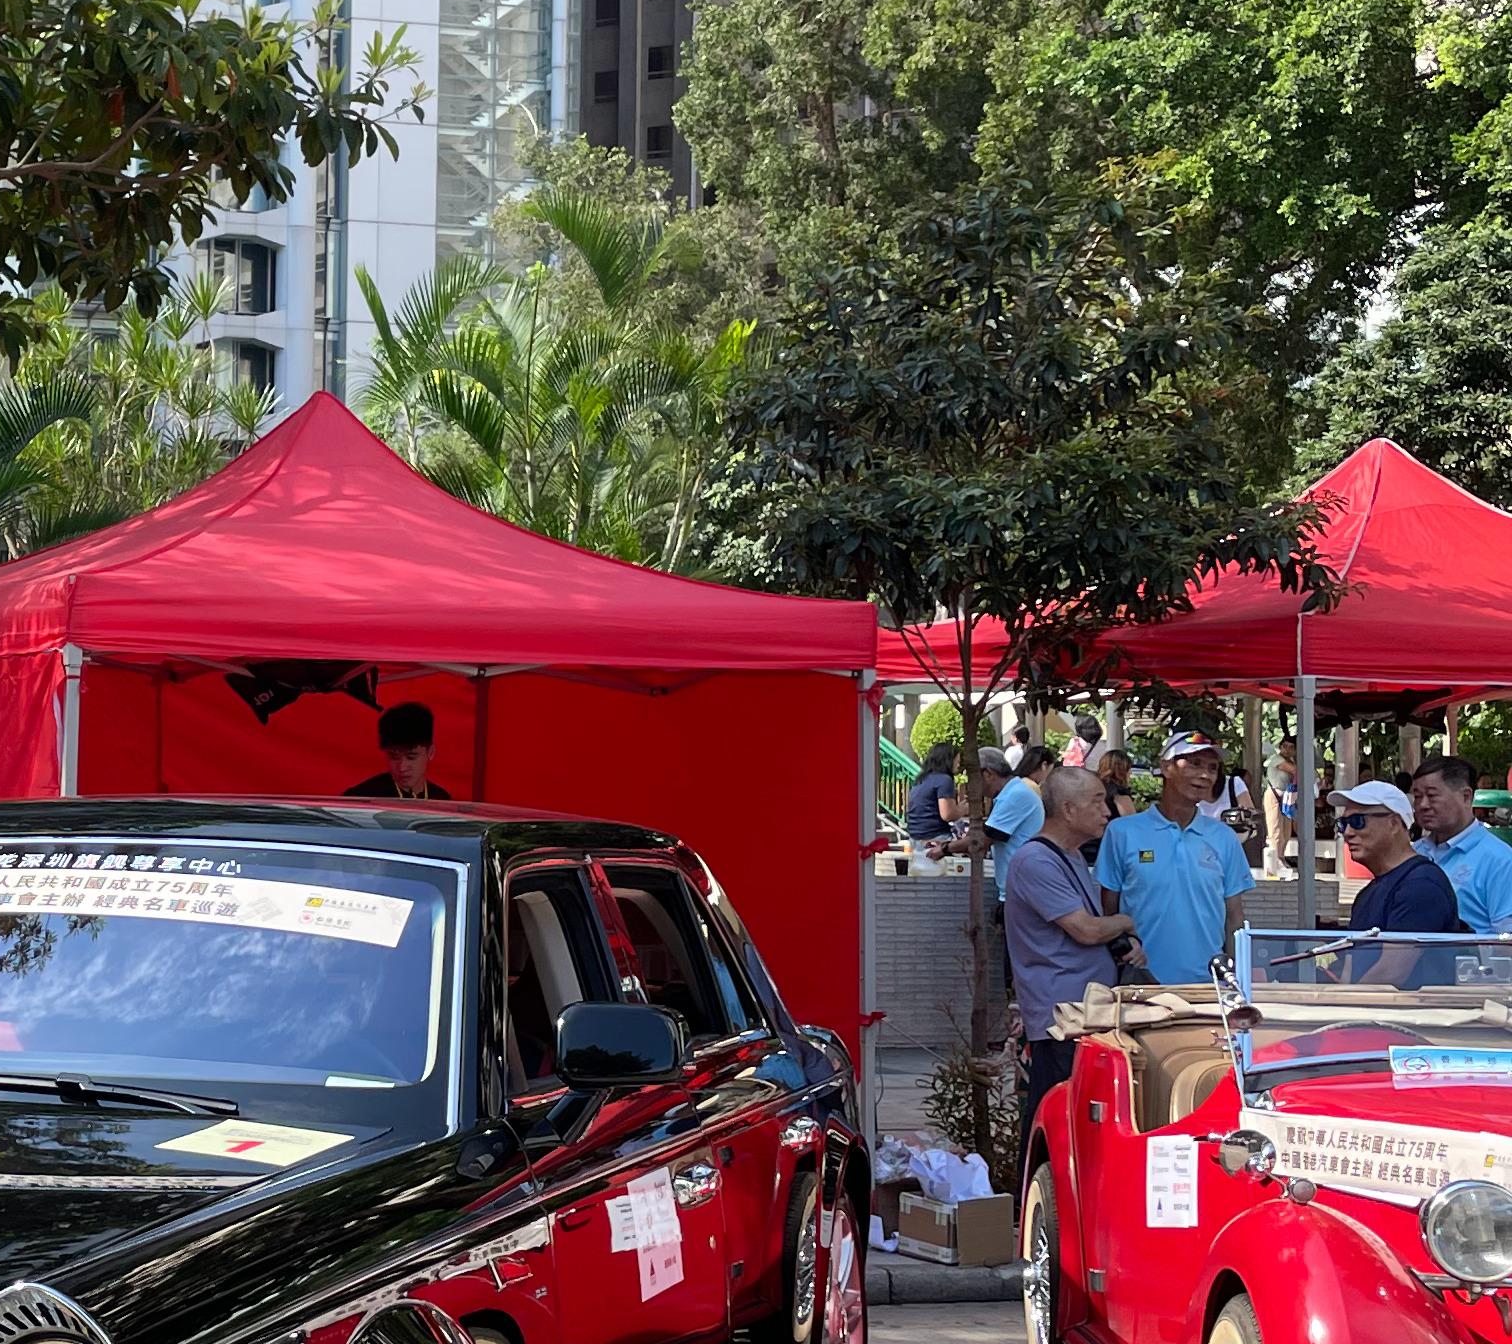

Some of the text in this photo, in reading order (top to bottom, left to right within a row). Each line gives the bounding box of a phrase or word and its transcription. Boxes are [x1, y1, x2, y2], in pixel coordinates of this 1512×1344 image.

[93, 894, 240, 917] 經典名車巡遊
[1286, 1126, 1450, 1161] 慶祝中華人民共和國成立75周年
[1281, 1150, 1374, 1178] 中國香港汽車會主辦
